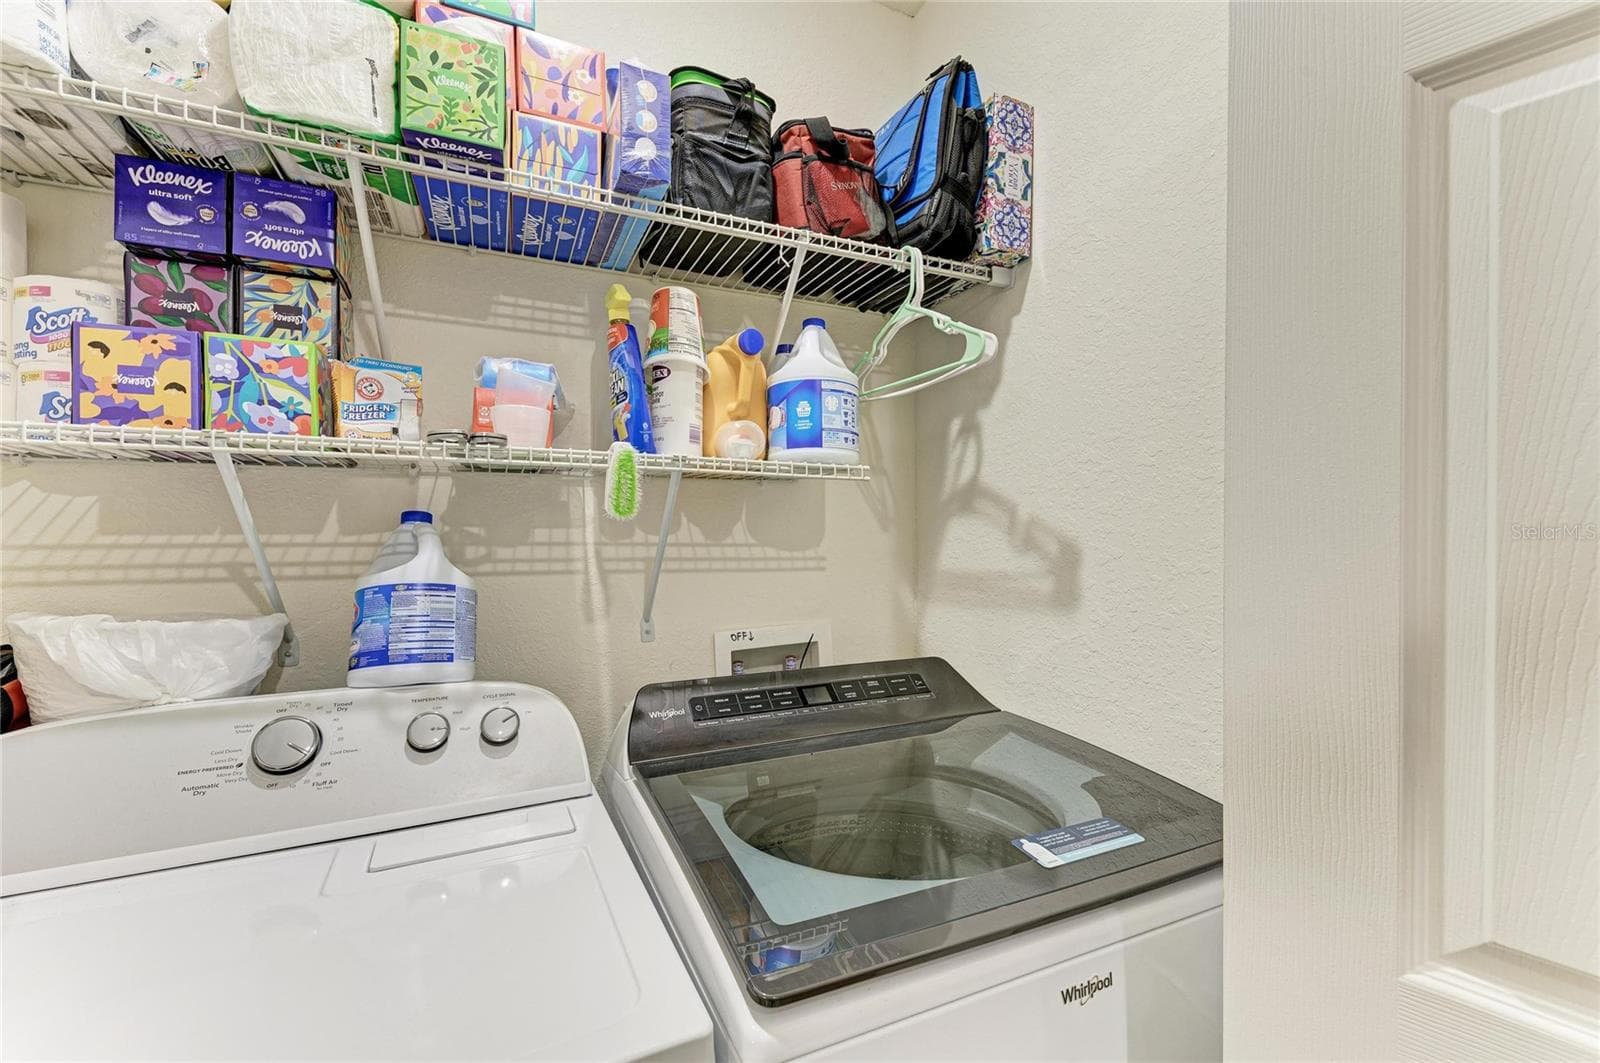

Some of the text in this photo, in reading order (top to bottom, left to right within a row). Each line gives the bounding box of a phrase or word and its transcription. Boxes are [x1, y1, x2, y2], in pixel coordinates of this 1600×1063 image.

[433, 75, 471, 92] Kleenex
[416, 137, 492, 160] Kleenex
[128, 164, 213, 194] Kleenex
[149, 189, 193, 201] ultra soft
[315, 189, 327, 197] 85
[428, 195, 462, 230] Kleenex
[124, 232, 138, 240] 85
[283, 227, 304, 236] ultra
[245, 231, 323, 259] Kleenex
[158, 299, 200, 313] Kleenex
[33, 308, 86, 334] Scott
[271, 311, 307, 325] Kleenex
[112, 374, 159, 388] Kleenex
[343, 404, 395, 412] FRIDGE-N-
[343, 412, 386, 420] FREEZER
[730, 631, 747, 641] OFF
[648, 708, 686, 720] Whirlpool
[201, 765, 235, 773] PREFERRED
[181, 783, 219, 792] Automatic
[1061, 972, 1113, 1005] Whirlpool
